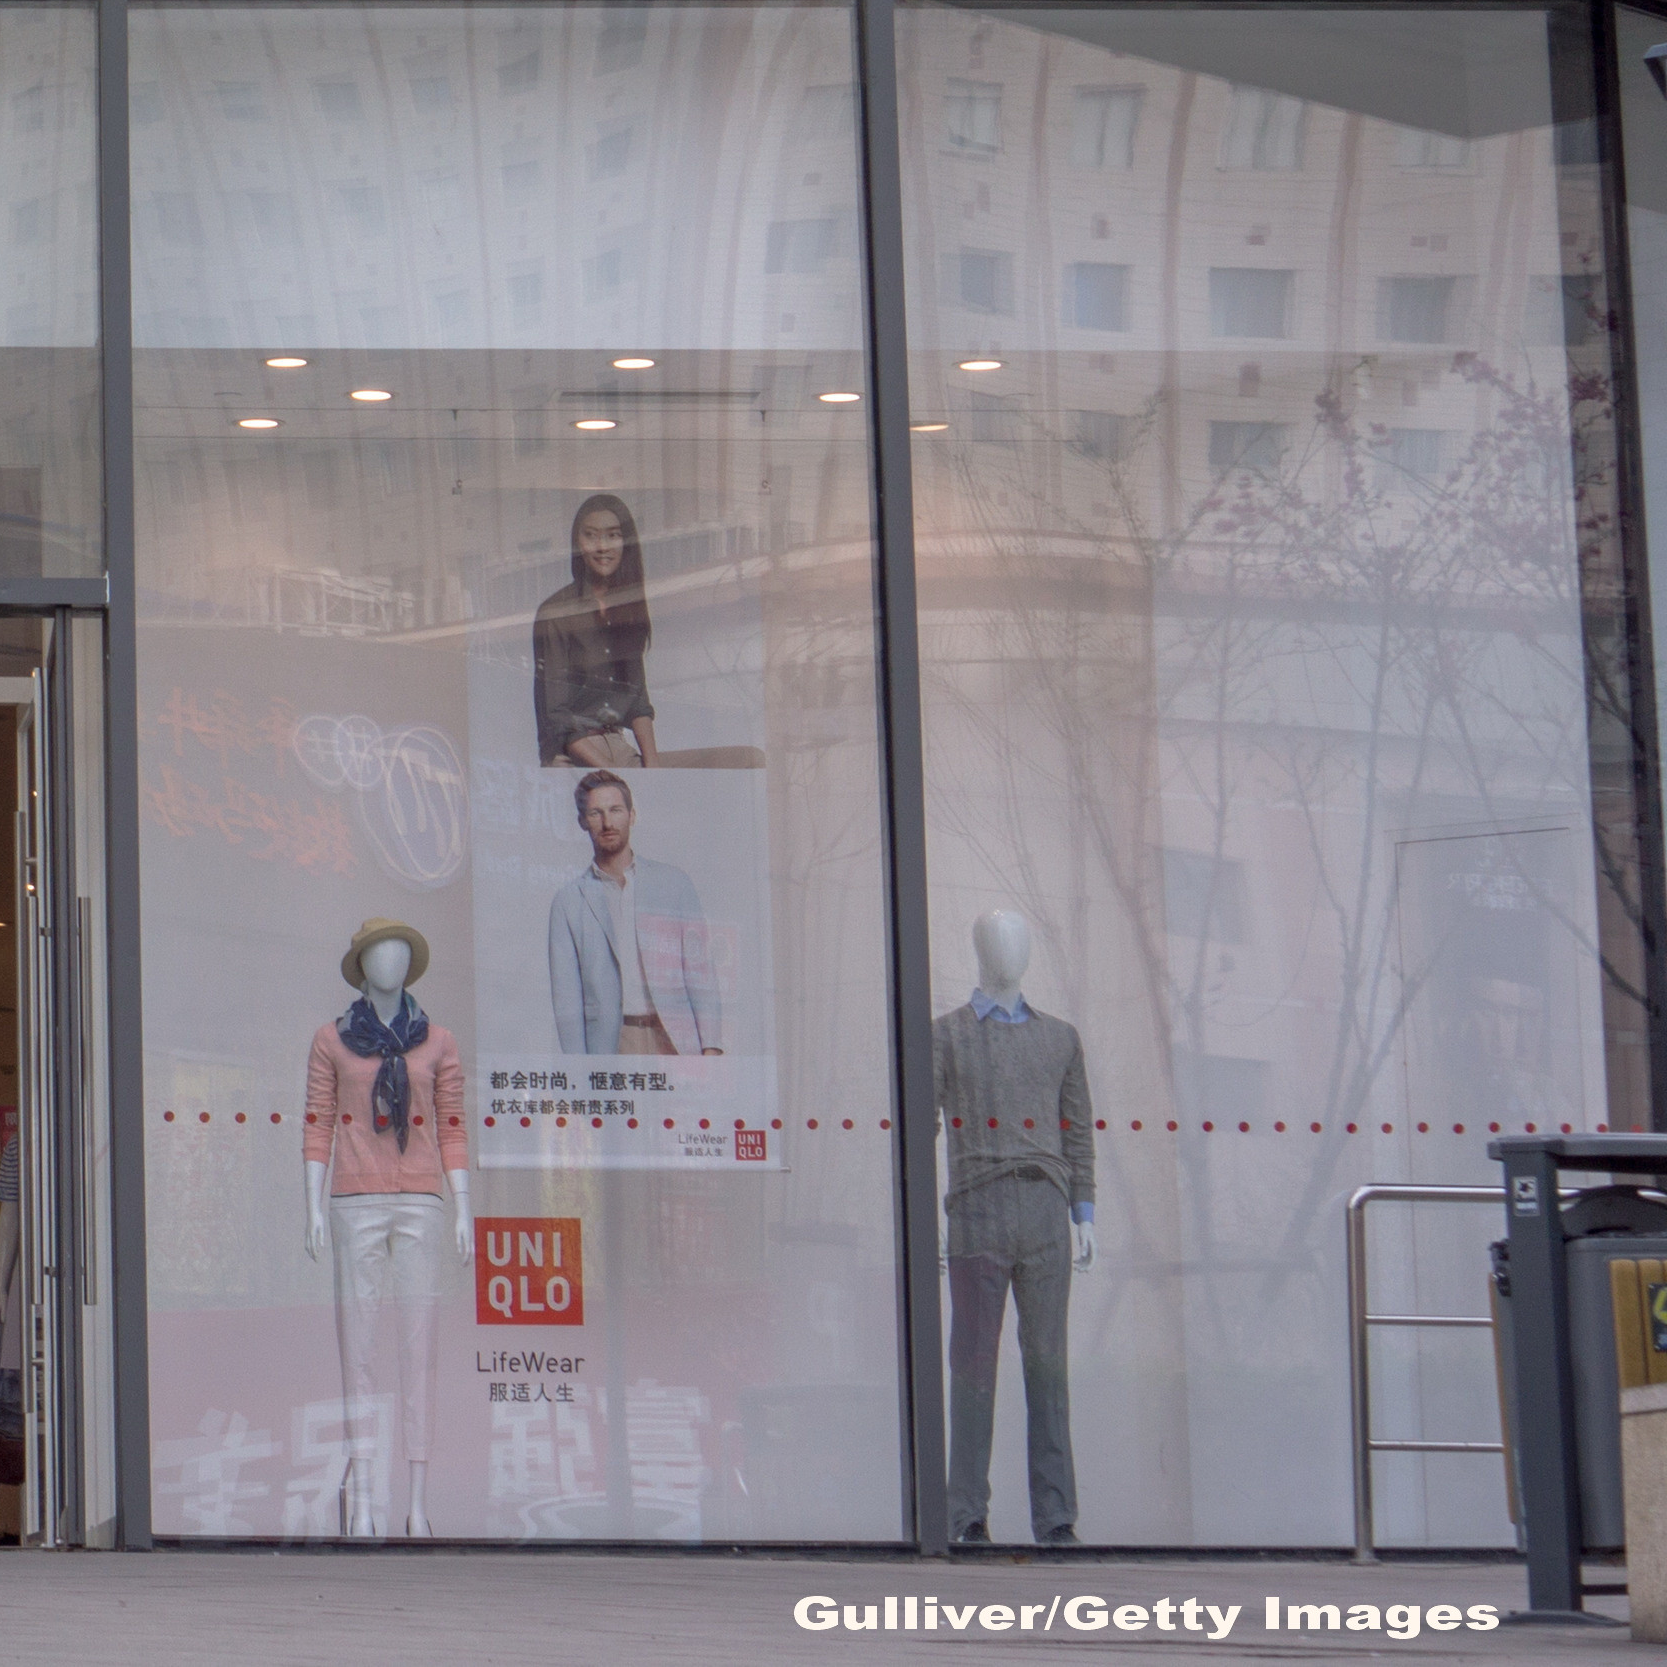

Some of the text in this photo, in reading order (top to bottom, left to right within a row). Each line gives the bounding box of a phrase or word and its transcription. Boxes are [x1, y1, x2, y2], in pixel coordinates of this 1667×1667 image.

[490, 1099, 635, 1116] 优衣库都会新贵系列
[678, 1133, 761, 1145] LifeWear UNI
[738, 1145, 763, 1159] QLO
[486, 1230, 562, 1268] UNI
[488, 1274, 571, 1318] QLO
[476, 1350, 586, 1374] LifeWear
[488, 1382, 575, 1403] 服适人生
